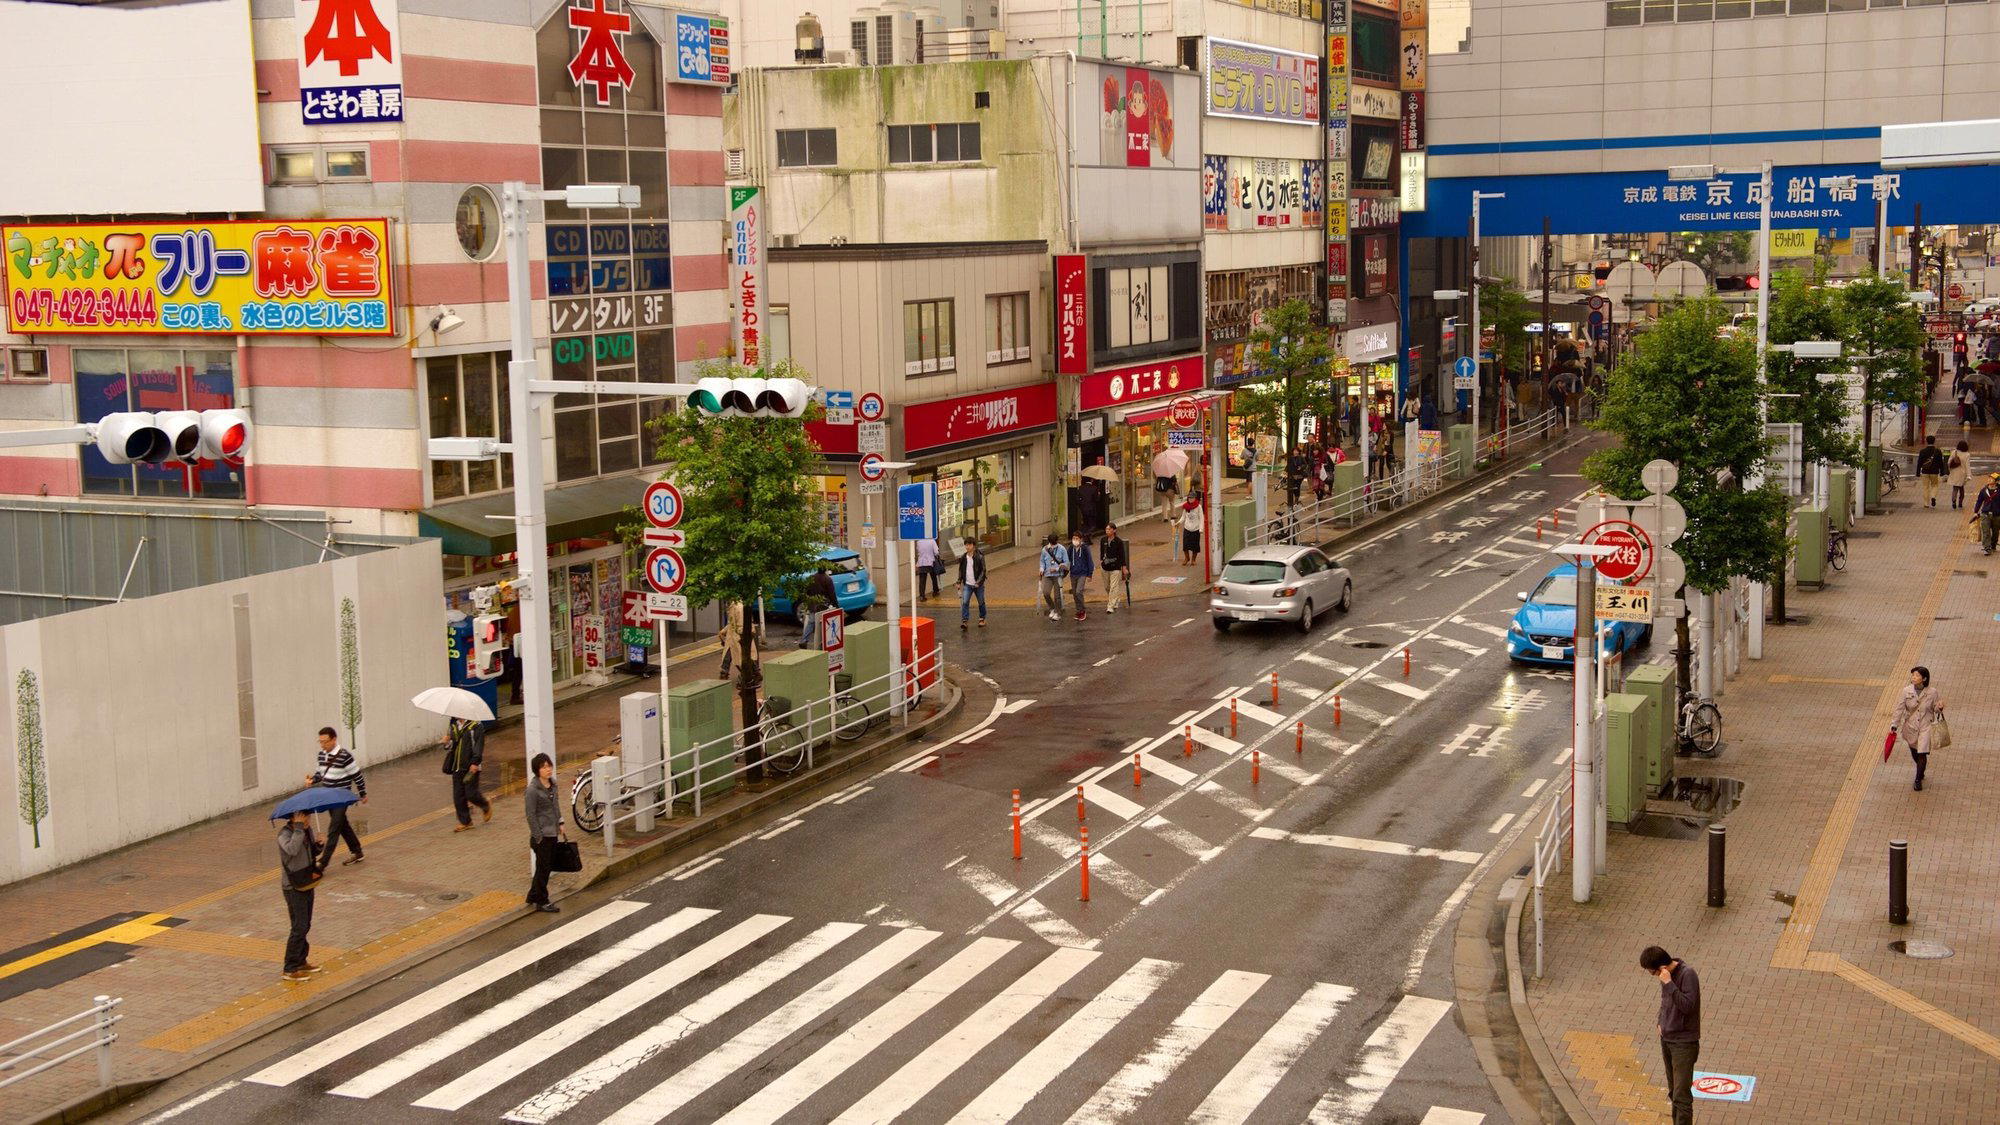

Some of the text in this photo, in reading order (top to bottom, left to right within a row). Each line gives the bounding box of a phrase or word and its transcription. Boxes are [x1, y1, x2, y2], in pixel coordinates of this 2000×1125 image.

[567, 0, 636, 105] 本
[304, 89, 402, 119] ときわ書房
[1128, 133, 1149, 150] 不二家
[734, 190, 747, 201] 2F
[1242, 176, 1300, 211] さくら水産
[1623, 184, 1697, 203] 京成 電鉄
[1679, 209, 1843, 221] KEISEI LINE KEISE UNABASHI STA.
[554, 229, 669, 251] CD DVD VIDEO
[736, 220, 748, 266] anan
[152, 226, 383, 299] フリー 麻雀
[571, 259, 650, 294] レンタル
[552, 295, 665, 333] レンタル 3F
[741, 271, 759, 367] ときわ書房
[1062, 293, 1075, 359] リハウス
[1131, 370, 1162, 395] 不二家
[653, 494, 675, 516] 30
[625, 594, 652, 627] 本
[1605, 595, 1649, 613] 玉川
